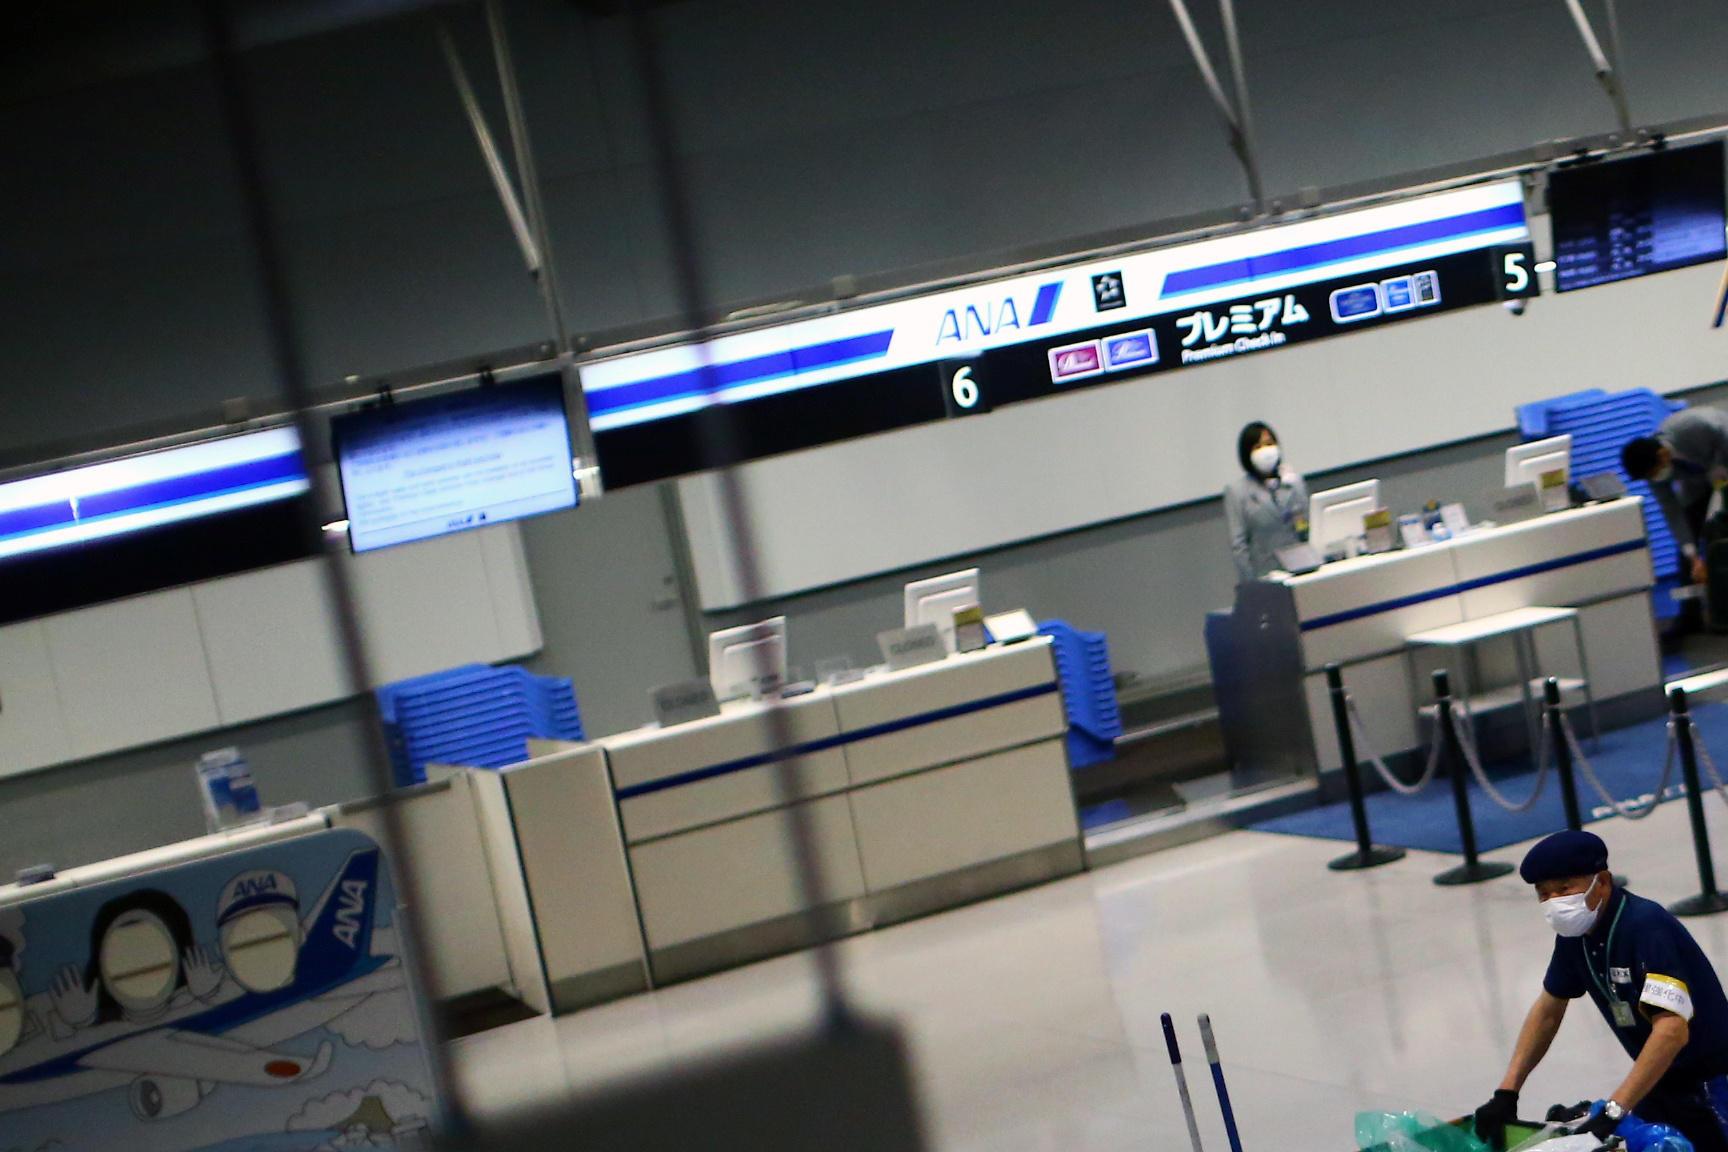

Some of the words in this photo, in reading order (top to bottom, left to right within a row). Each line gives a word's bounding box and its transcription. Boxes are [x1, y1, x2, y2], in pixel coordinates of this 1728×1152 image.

[1503, 253, 1529, 292] 5
[936, 297, 1020, 346] ANA
[1175, 294, 1310, 348] プレミアム
[952, 365, 979, 409] 6
[232, 874, 278, 898] ANA
[331, 878, 369, 950] ANA
